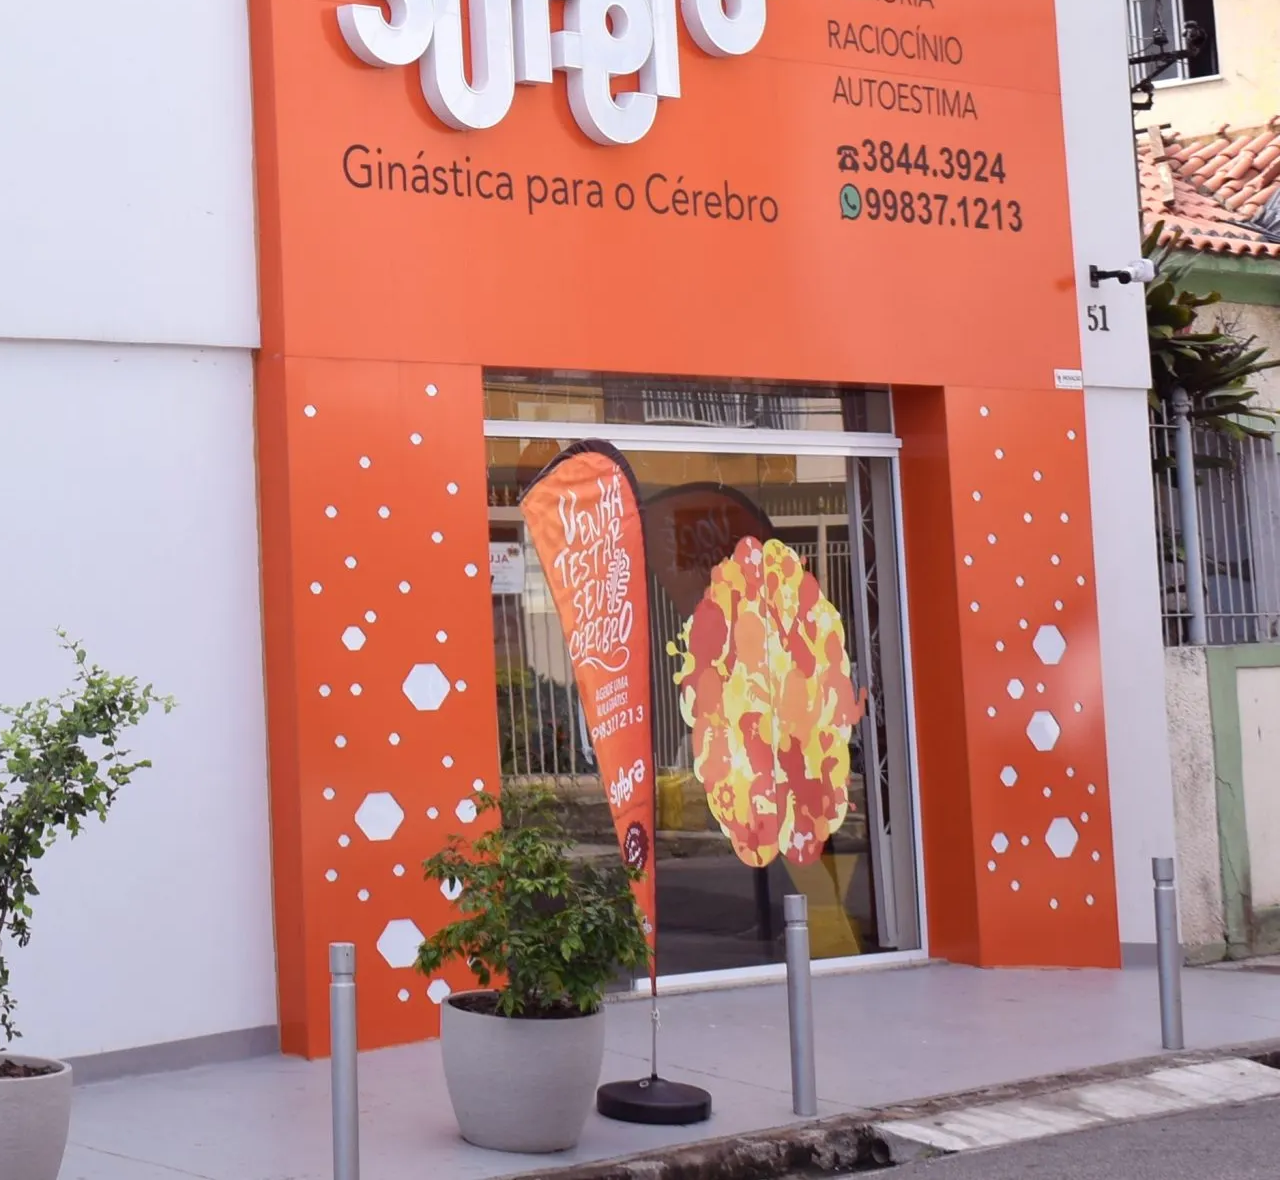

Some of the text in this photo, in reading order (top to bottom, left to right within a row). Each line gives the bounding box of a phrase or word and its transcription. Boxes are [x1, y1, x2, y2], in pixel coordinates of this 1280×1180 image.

[828, 19, 963, 66] RACIOCÍNIO
[833, 76, 978, 120] AUTOESTIMA
[342, 144, 779, 224] Ginástica para o Cérebro
[862, 139, 1006, 184] 3844.3924
[865, 188, 1023, 233] 99837.1213
[1087, 304, 1110, 332] 51
[558, 475, 624, 545] VENHA
[554, 517, 624, 589] TESTAR
[573, 579, 605, 624] SEU
[569, 600, 633, 661] CÉREBRO
